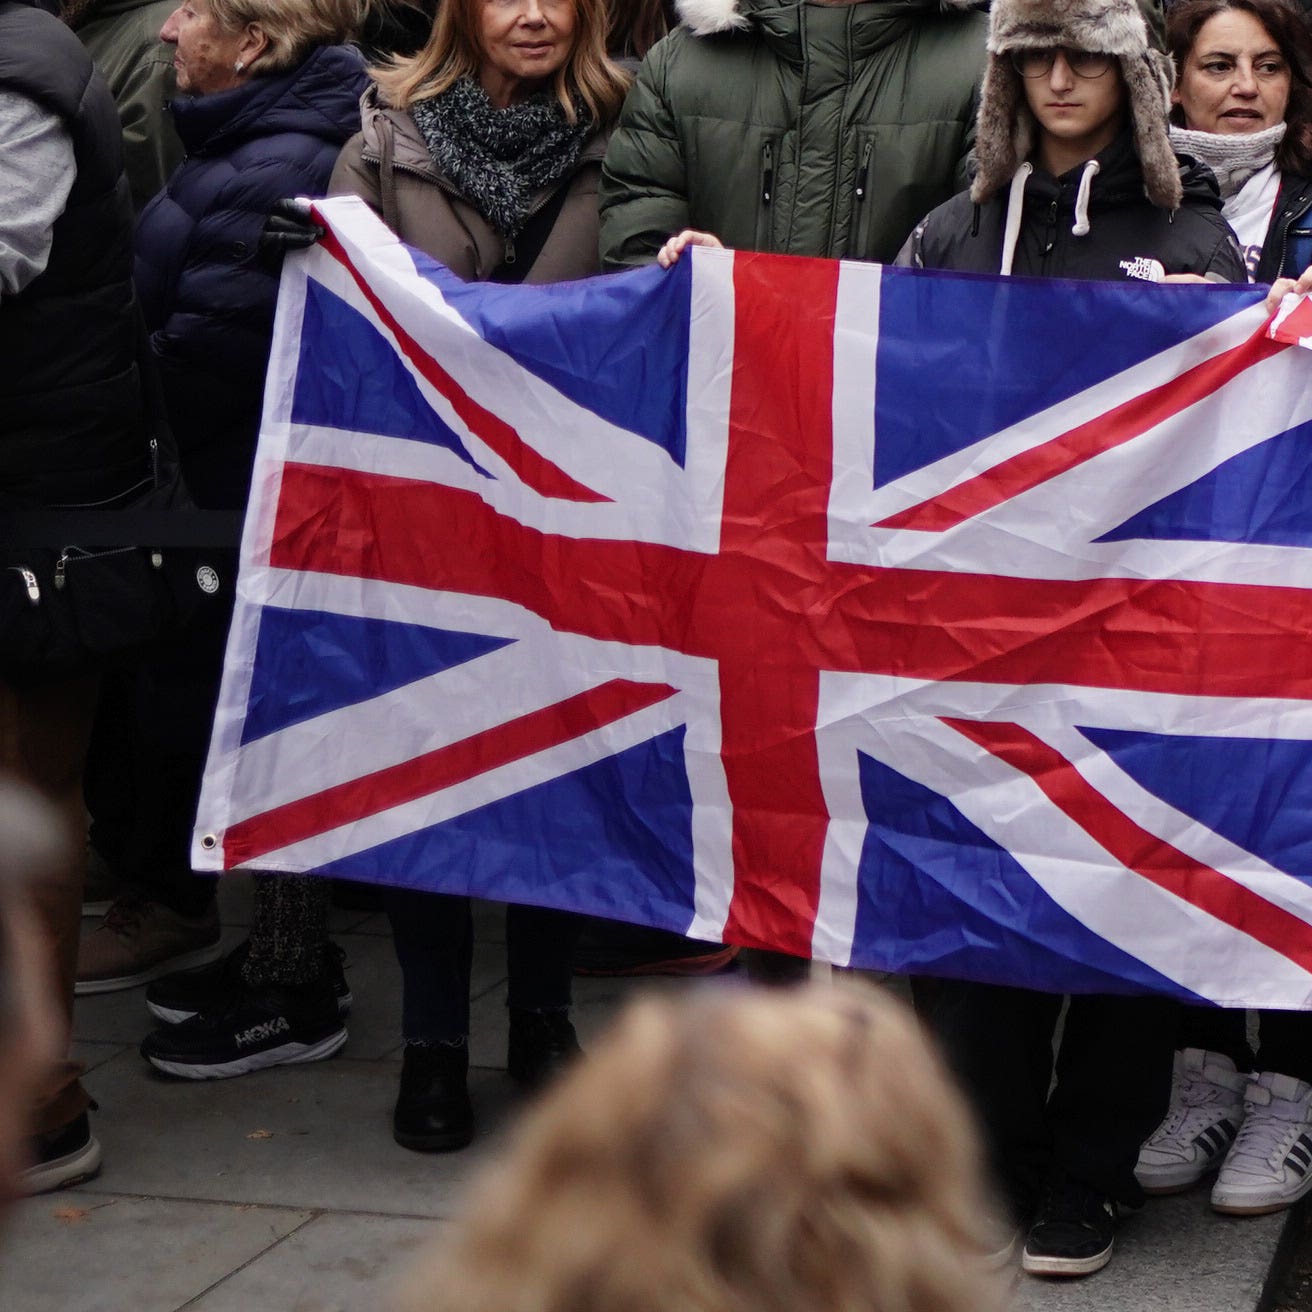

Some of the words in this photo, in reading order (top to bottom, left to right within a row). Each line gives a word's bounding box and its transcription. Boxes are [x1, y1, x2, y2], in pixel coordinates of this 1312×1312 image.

[1119, 260, 1151, 274] NORTH
[1134, 256, 1152, 266] THE
[1126, 269, 1150, 281] FACE
